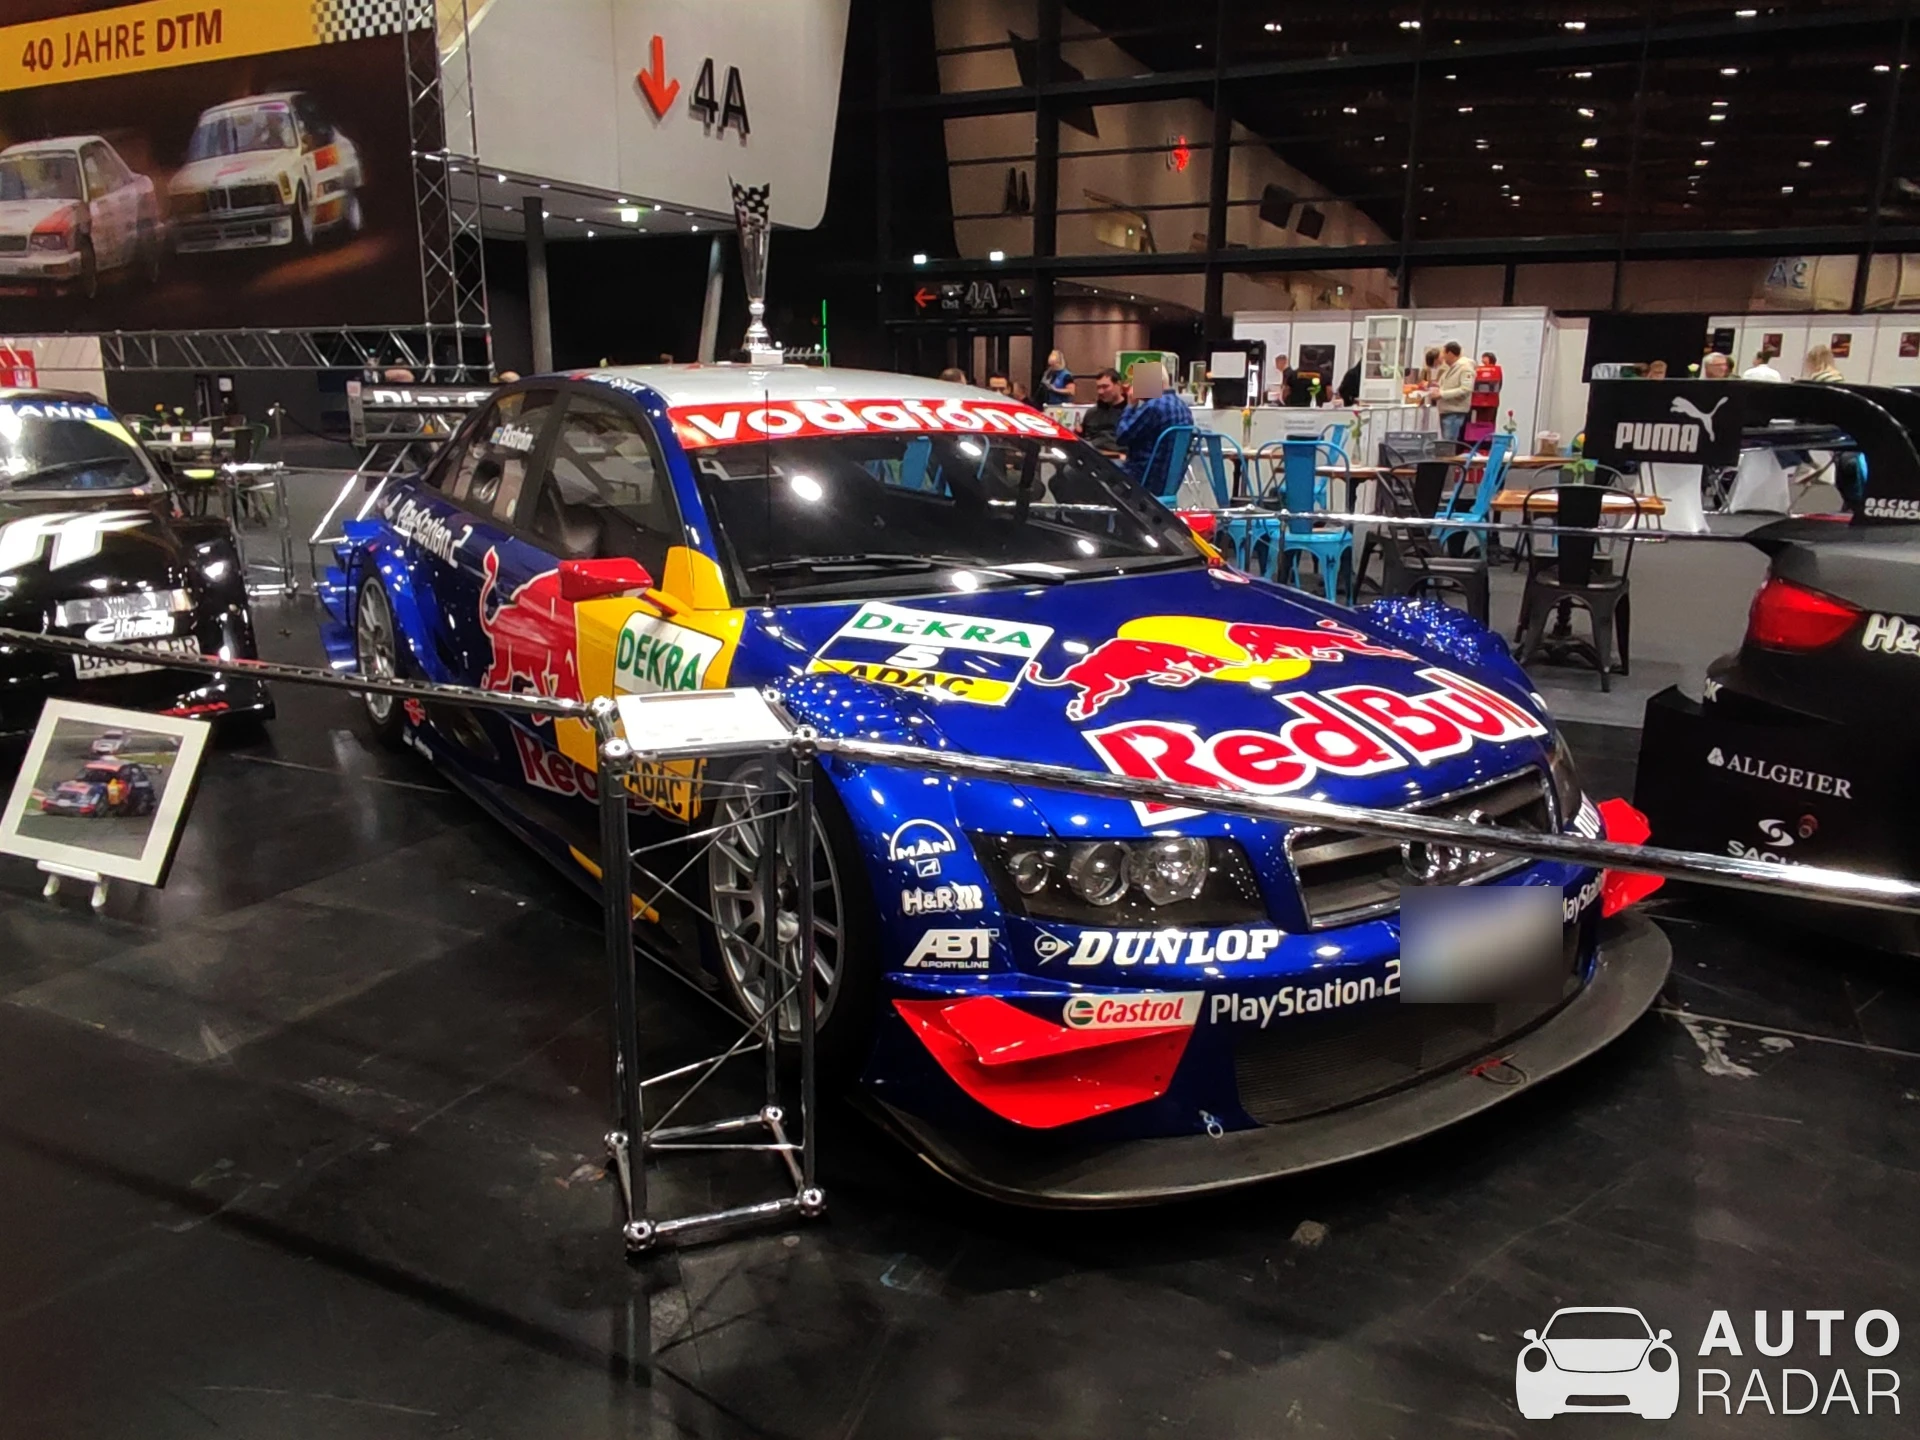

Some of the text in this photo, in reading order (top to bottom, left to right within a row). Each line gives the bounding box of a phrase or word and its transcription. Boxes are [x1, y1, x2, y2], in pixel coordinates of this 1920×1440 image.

[22, 8, 222, 72] 40 JAHRE DTM
[693, 57, 750, 134] 4A
[964, 281, 999, 309] 4A
[686, 400, 1058, 440] vodafone
[1614, 422, 1700, 453] PUMA
[1864, 507, 1920, 520] CARBO
[852, 612, 1032, 648] DEKRA
[1862, 613, 1920, 656] H&
[617, 627, 701, 691] DEKRA
[884, 644, 945, 669] 5
[843, 664, 975, 696] ADAC
[1084, 668, 1546, 827] Red Bull
[627, 761, 683, 816] ADAC
[1726, 754, 1853, 800] ALLGEIER
[896, 839, 951, 860] MAN
[902, 887, 956, 917] H&R
[903, 928, 989, 967] ABT
[920, 960, 989, 969] SPORTSLINE
[1067, 929, 1279, 966] DUNLOP
[1096, 997, 1185, 1025] Castrol
